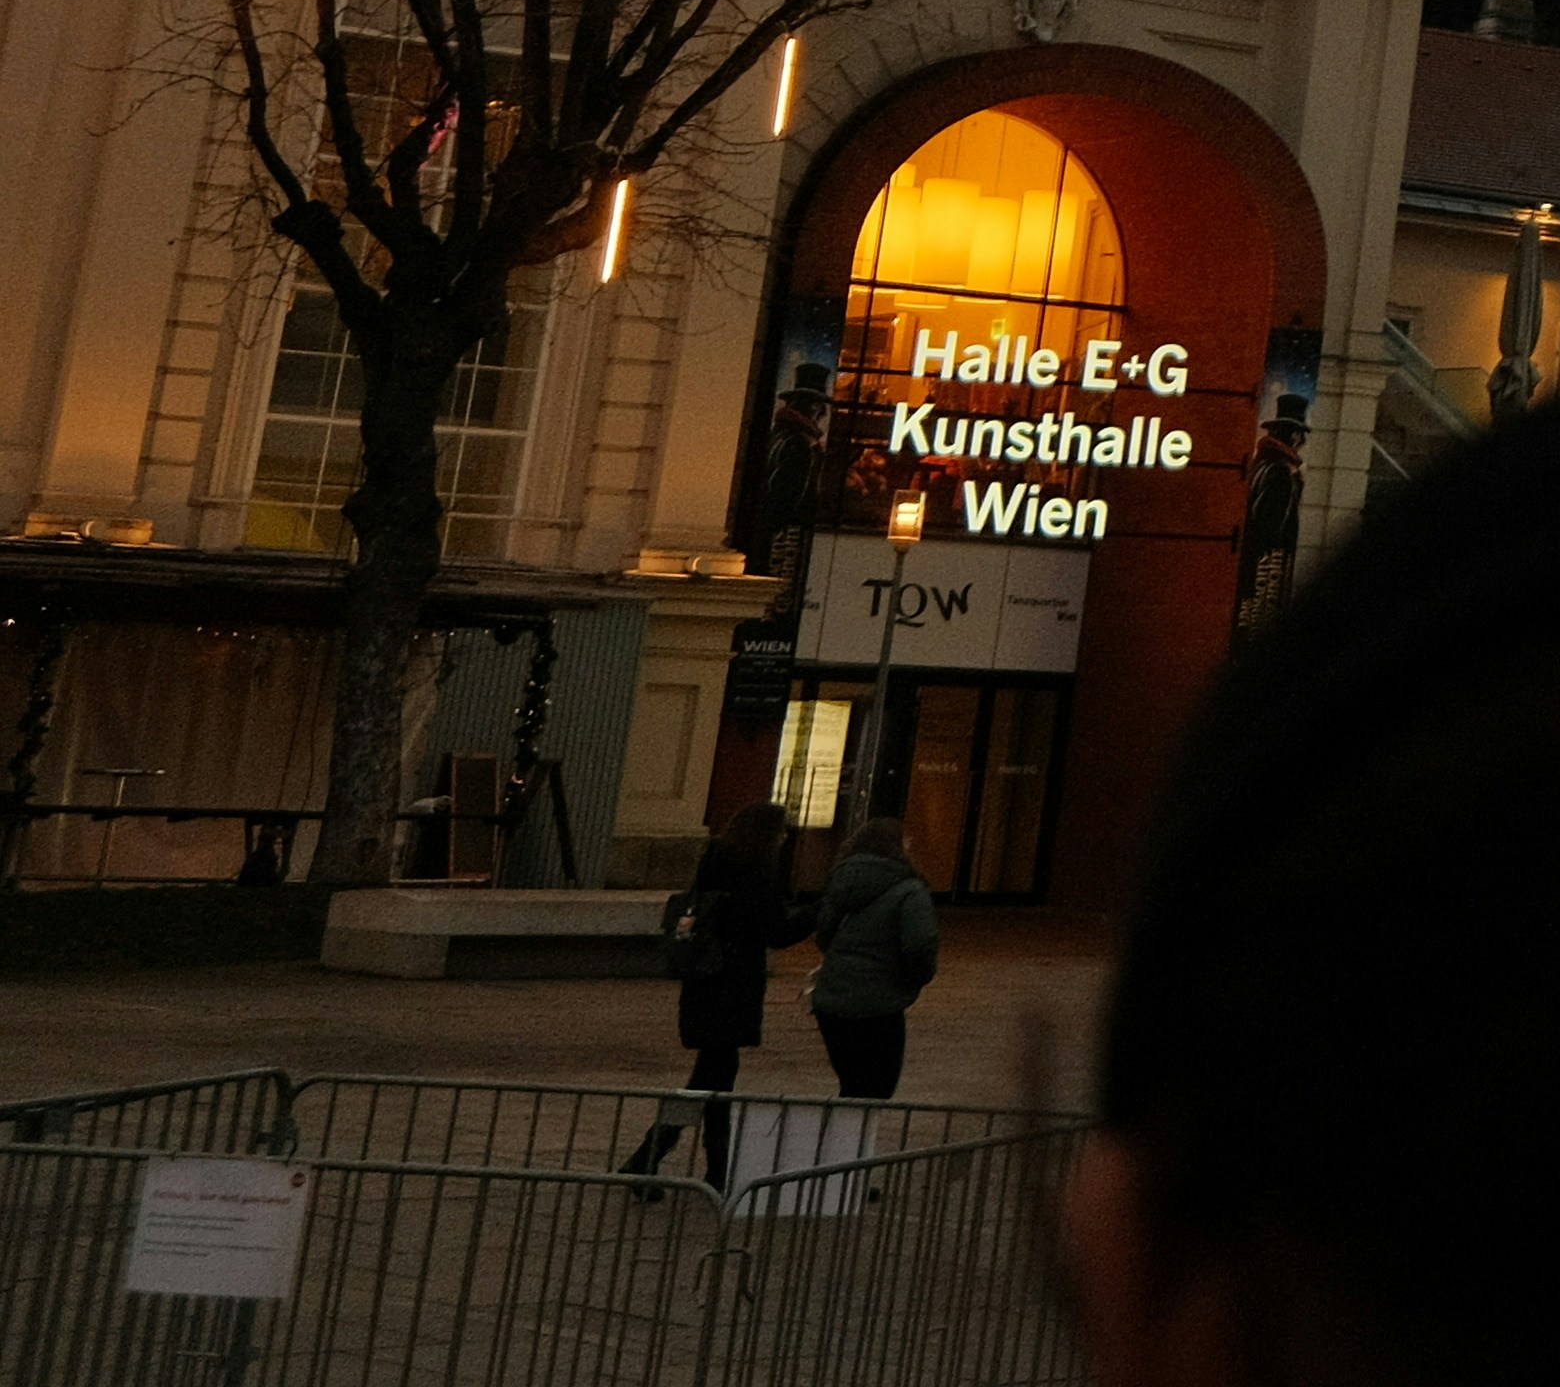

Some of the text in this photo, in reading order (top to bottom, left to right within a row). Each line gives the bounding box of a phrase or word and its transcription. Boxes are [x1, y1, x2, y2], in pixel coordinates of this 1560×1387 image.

[911, 328, 1189, 397] Halle E+G
[888, 401, 1193, 470] Kunsthalle
[963, 479, 1109, 540] Wien
[862, 579, 974, 627] TQW
[743, 640, 792, 653] WIEN
